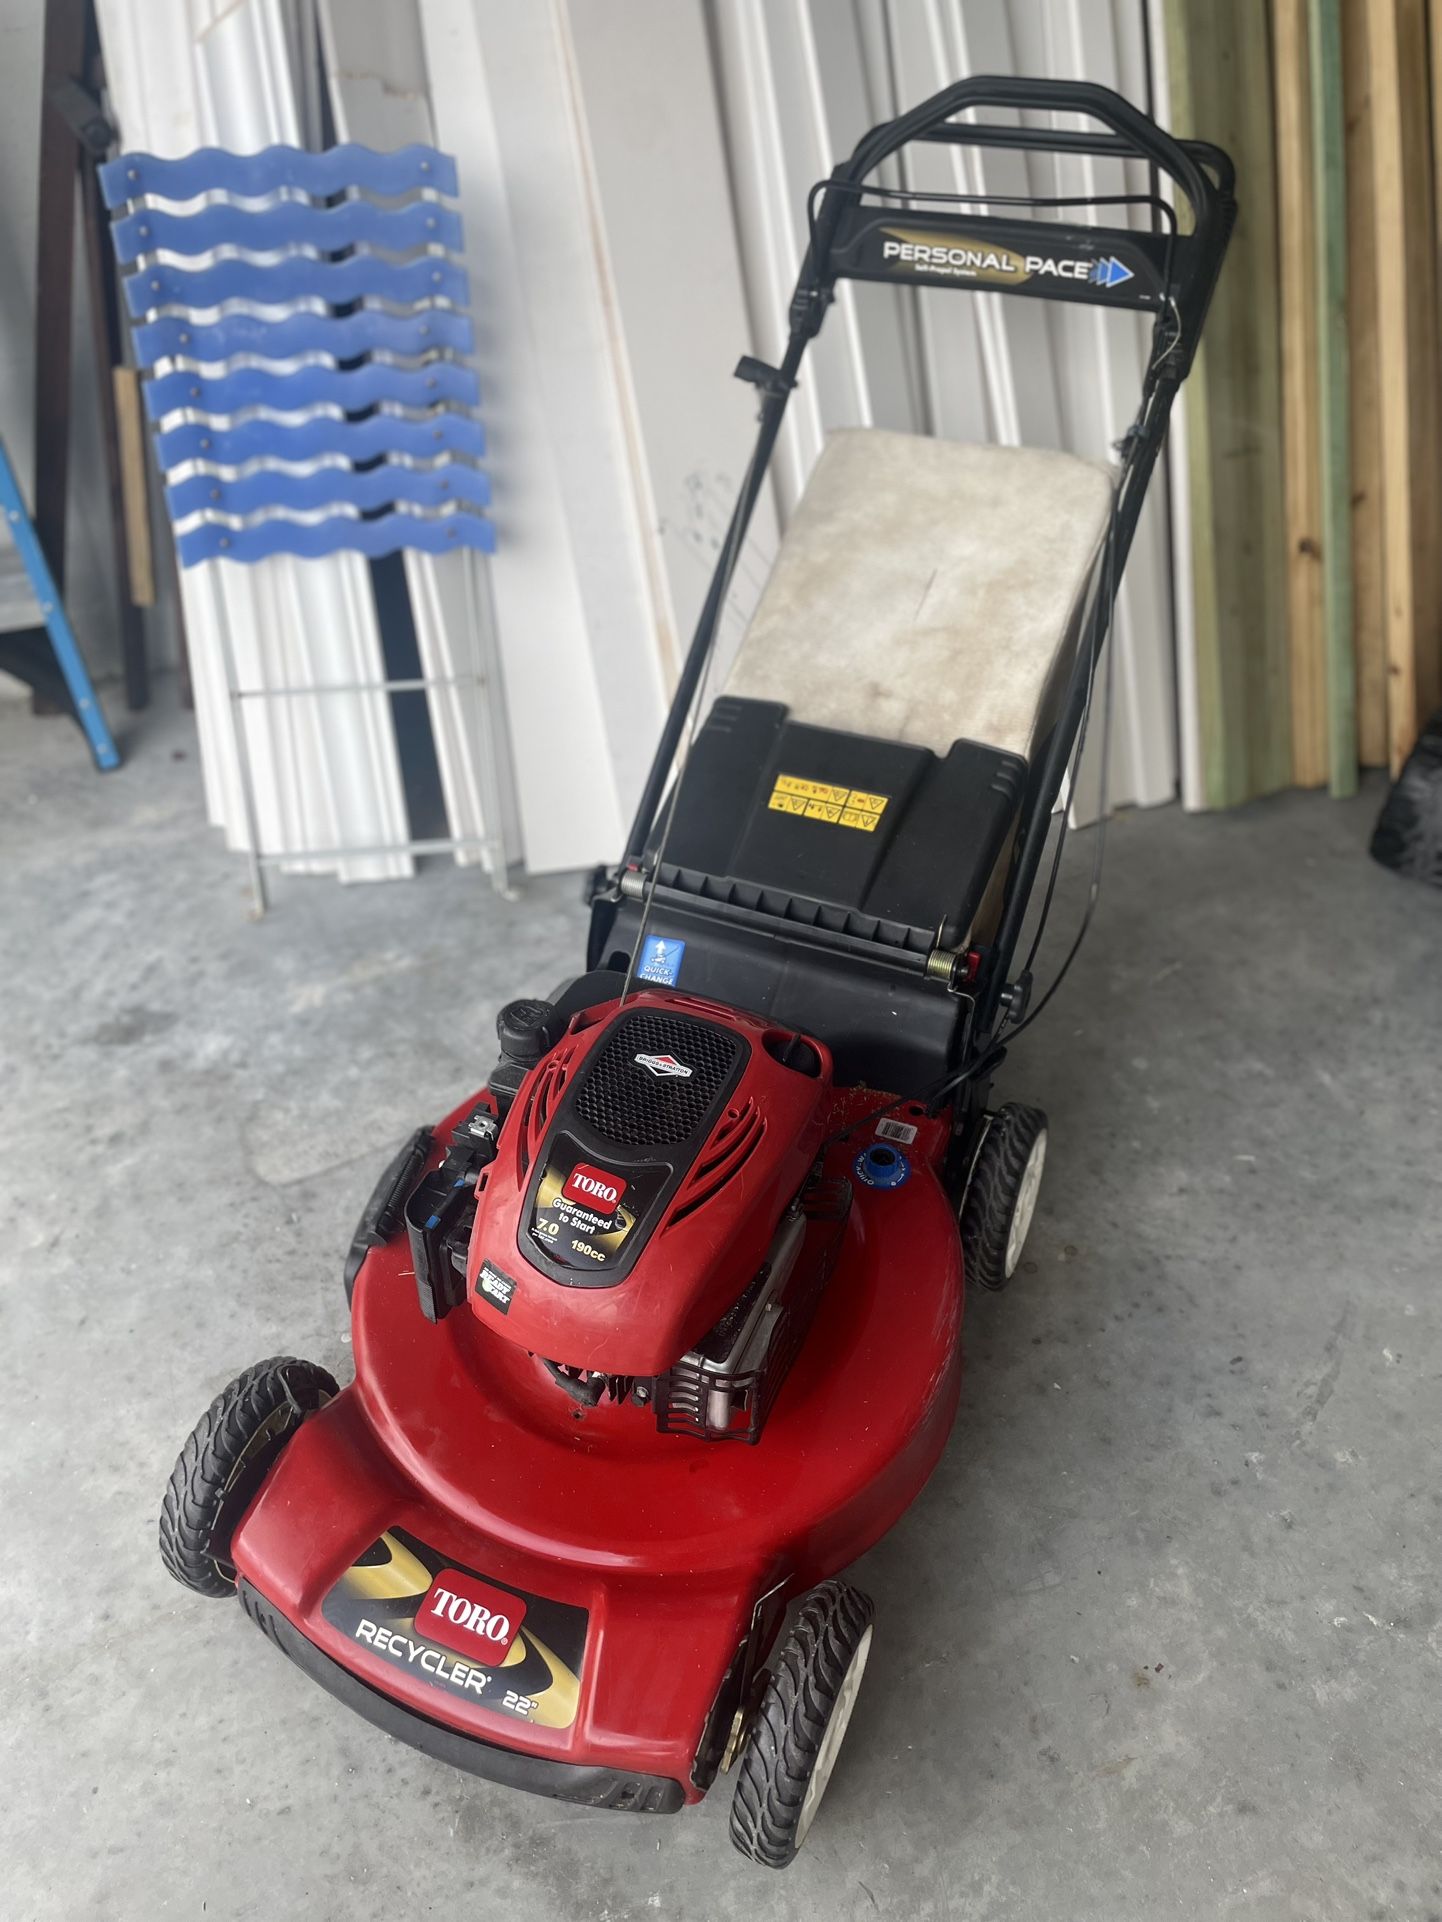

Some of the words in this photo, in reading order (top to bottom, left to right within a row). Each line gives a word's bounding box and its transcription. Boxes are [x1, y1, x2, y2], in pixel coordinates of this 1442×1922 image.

[883, 241, 1015, 271] PERSONAL
[1024, 255, 1090, 279] PACE
[639, 973, 674, 985] CHANGE
[572, 1171, 615, 1202] TORO
[552, 1197, 613, 1230] Guaranteed
[558, 1212, 570, 1224] to
[570, 1216, 596, 1235] Start
[536, 1218, 560, 1236] 7.0
[571, 1239, 607, 1262] 190cc
[430, 1587, 509, 1641] TORO
[355, 1618, 488, 1695] RECYCLER
